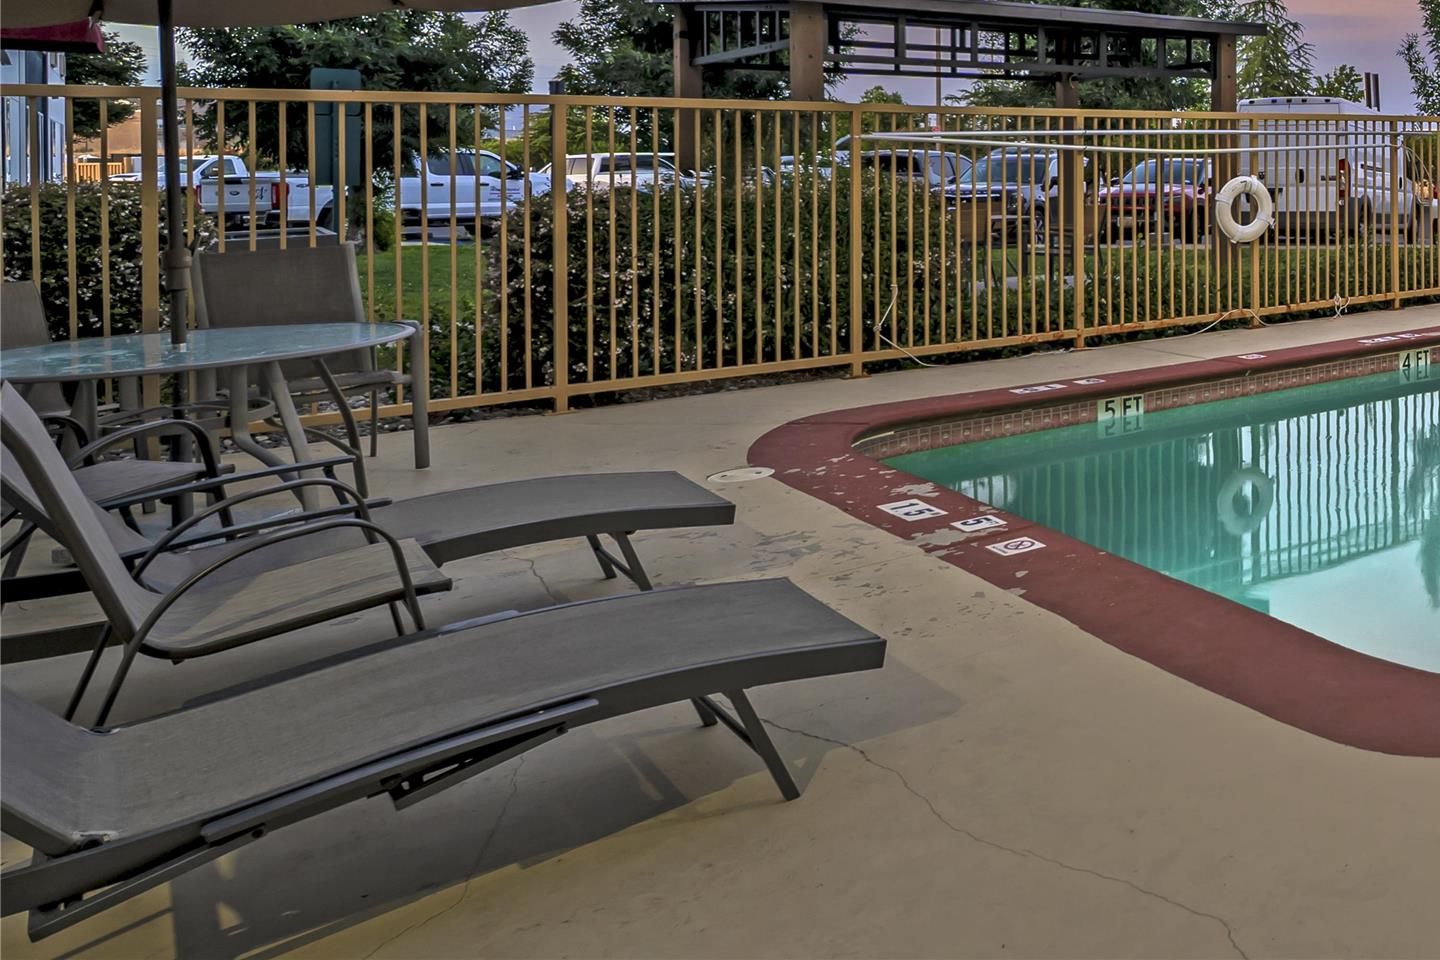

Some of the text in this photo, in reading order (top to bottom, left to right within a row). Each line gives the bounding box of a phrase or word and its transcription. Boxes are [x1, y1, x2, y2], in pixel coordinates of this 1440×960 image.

[1402, 350, 1430, 369] 4 FT
[1104, 396, 1142, 419] 5 FT
[960, 516, 992, 527] 5
